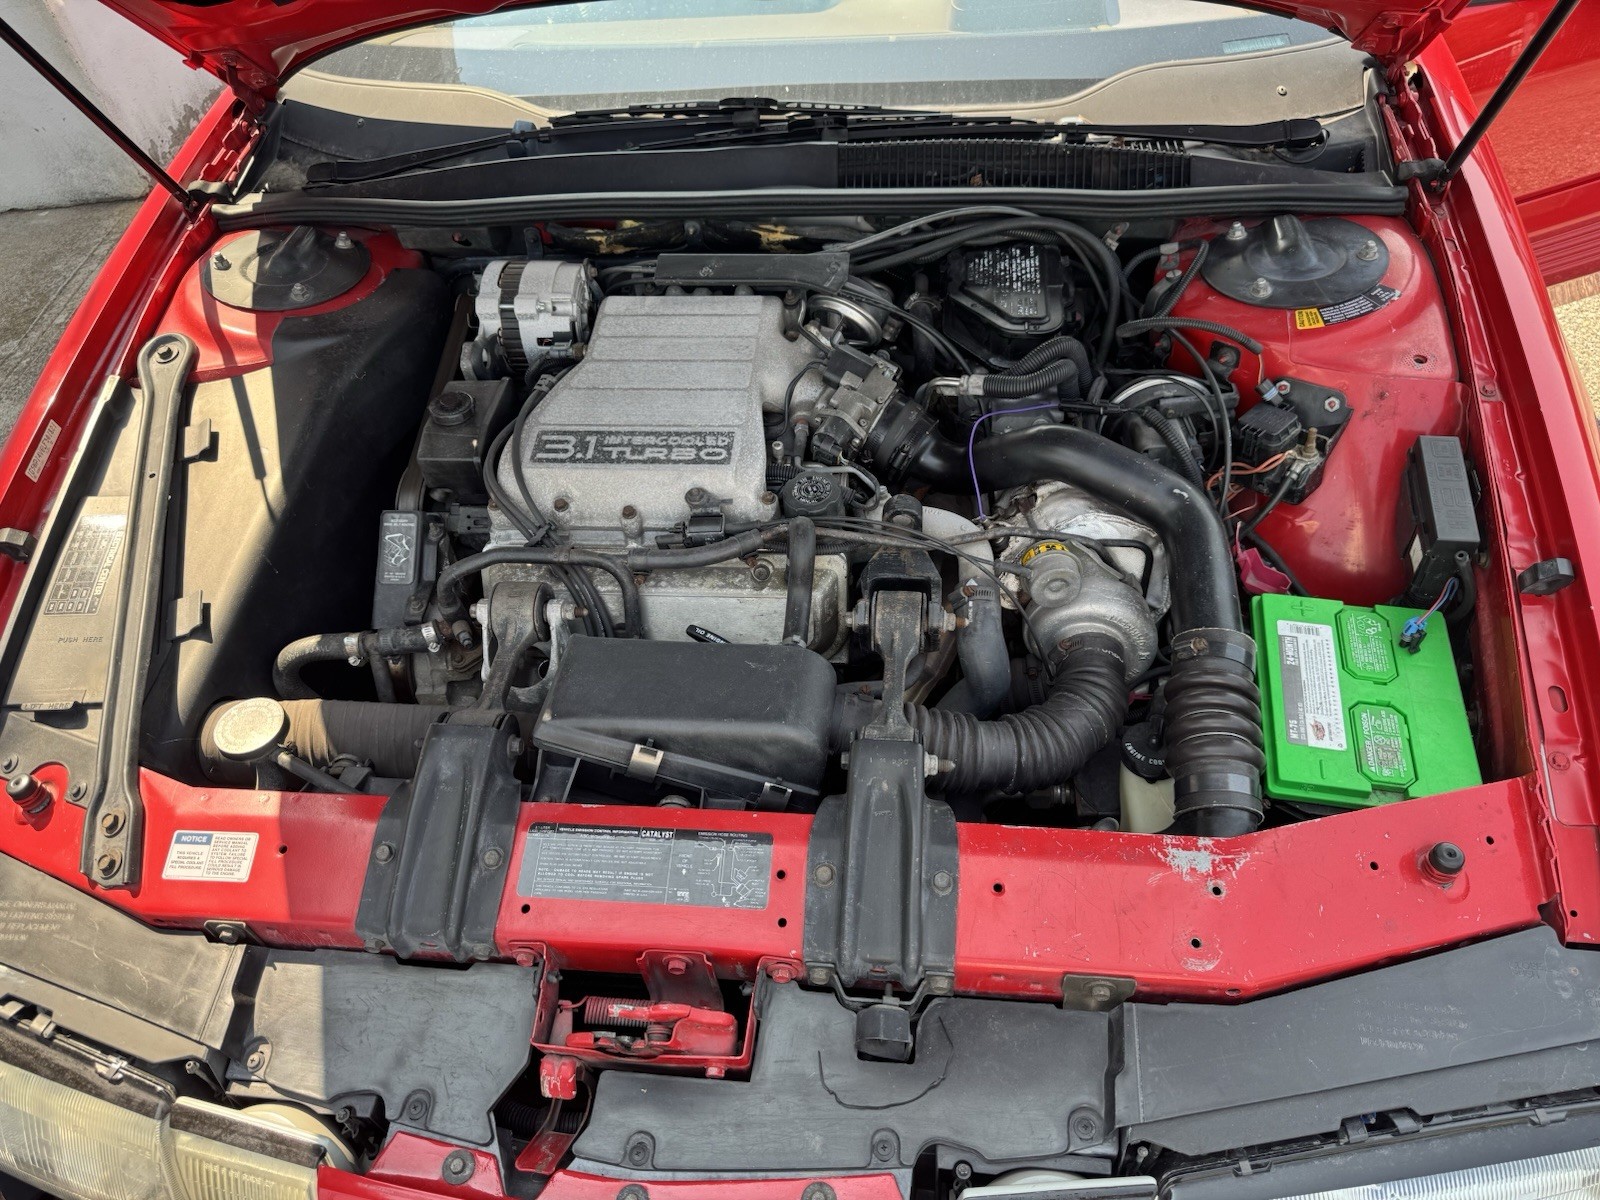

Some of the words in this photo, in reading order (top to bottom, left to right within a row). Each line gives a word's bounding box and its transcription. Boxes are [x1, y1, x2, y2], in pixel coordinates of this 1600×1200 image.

[535, 435, 596, 459] 3.1
[602, 448, 727, 460] TURBO
[94, 568, 109, 596] CENTER
[1361, 712, 1370, 734] POISON
[1365, 740, 1375, 766] DANGER
